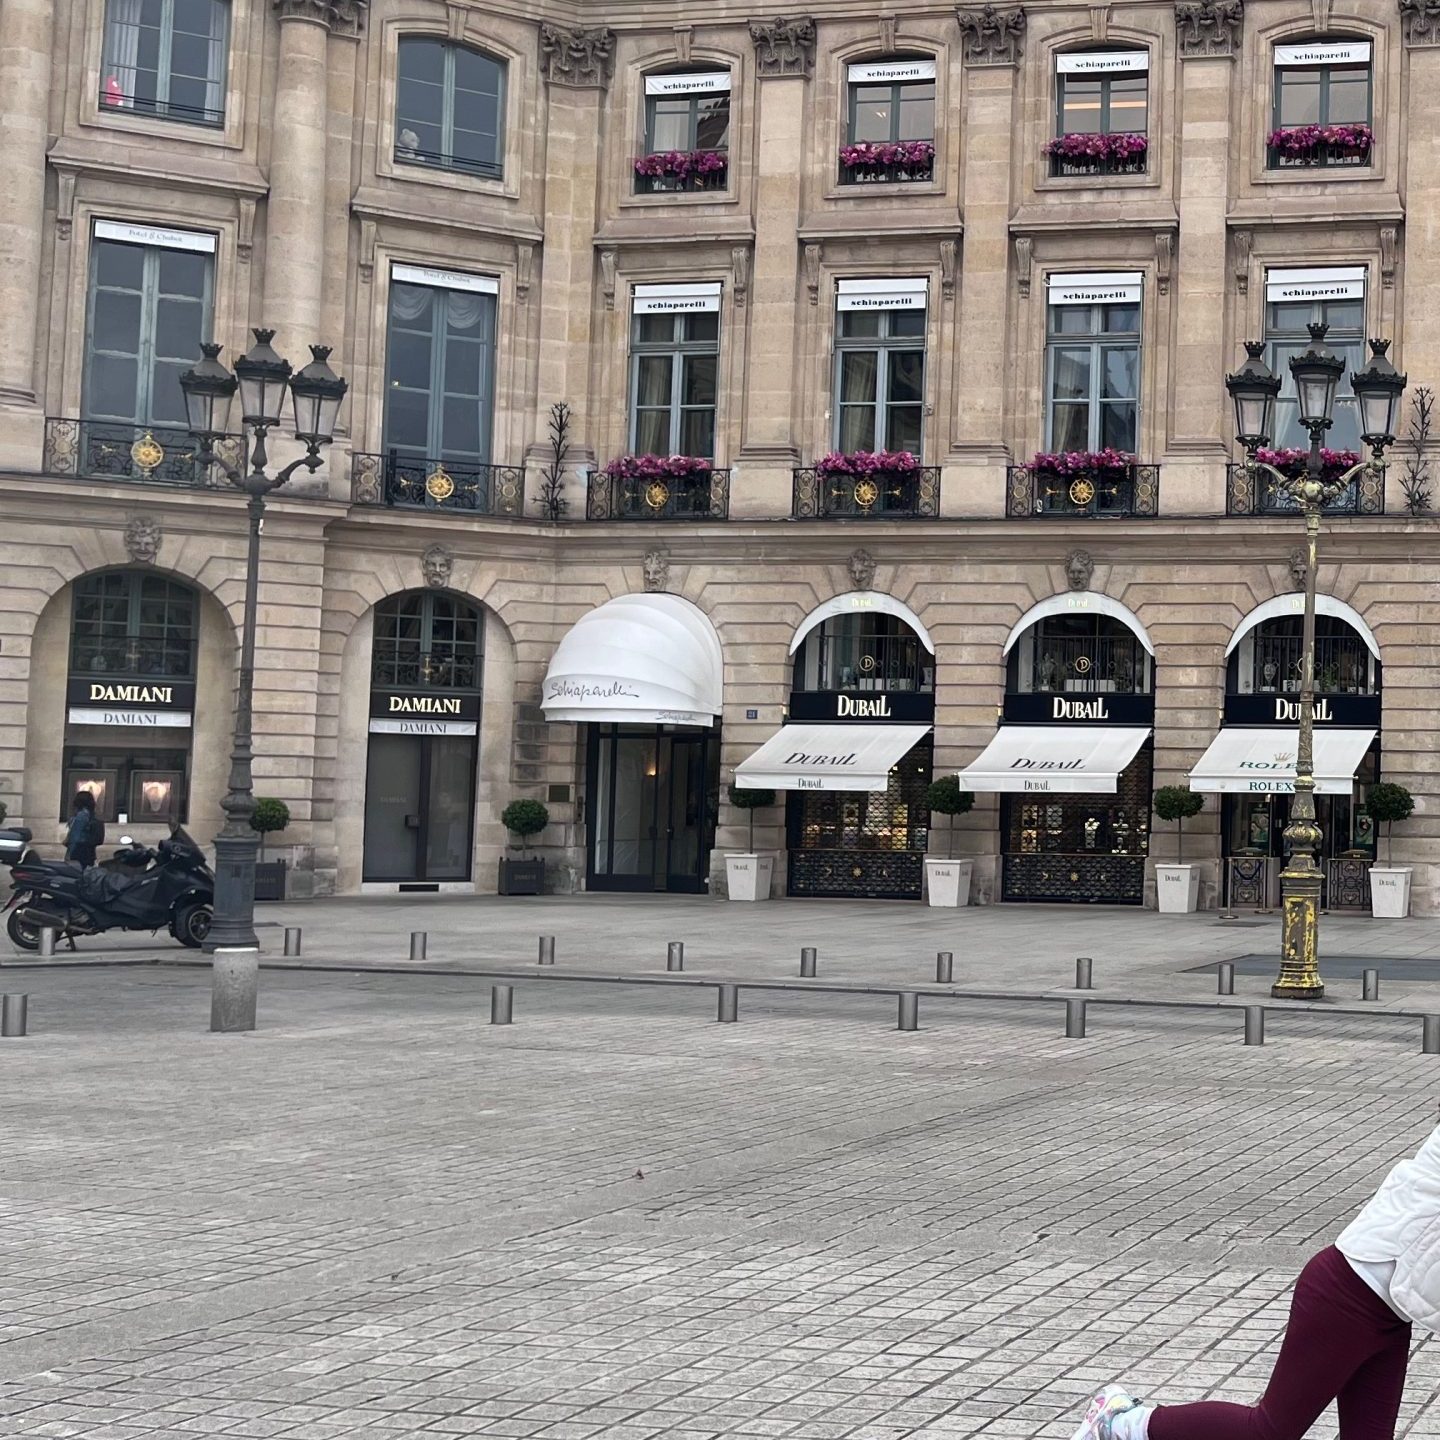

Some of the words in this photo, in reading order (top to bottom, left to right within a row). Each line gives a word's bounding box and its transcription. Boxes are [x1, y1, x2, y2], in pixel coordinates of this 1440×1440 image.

[1294, 51, 1351, 62] schiaparelli
[1075, 60, 1132, 70] schiaparelli
[867, 69, 920, 79] schiaparelli
[663, 81, 715, 91] schiaparelli
[1063, 291, 1126, 302] schiaparelli
[1282, 287, 1348, 298] schiaparelli
[647, 301, 706, 310] schiaparelli
[851, 298, 912, 308] schiaparelli
[90, 684, 172, 703] DAMIANI
[389, 696, 461, 714] DAMIANI
[1275, 698, 1333, 720] DUAIL
[104, 712, 157, 725] DAMIANI
[400, 722, 447, 734] DAMIANI
[1239, 761, 1299, 769] ROLE
[1249, 782, 1294, 791] ROLEX
